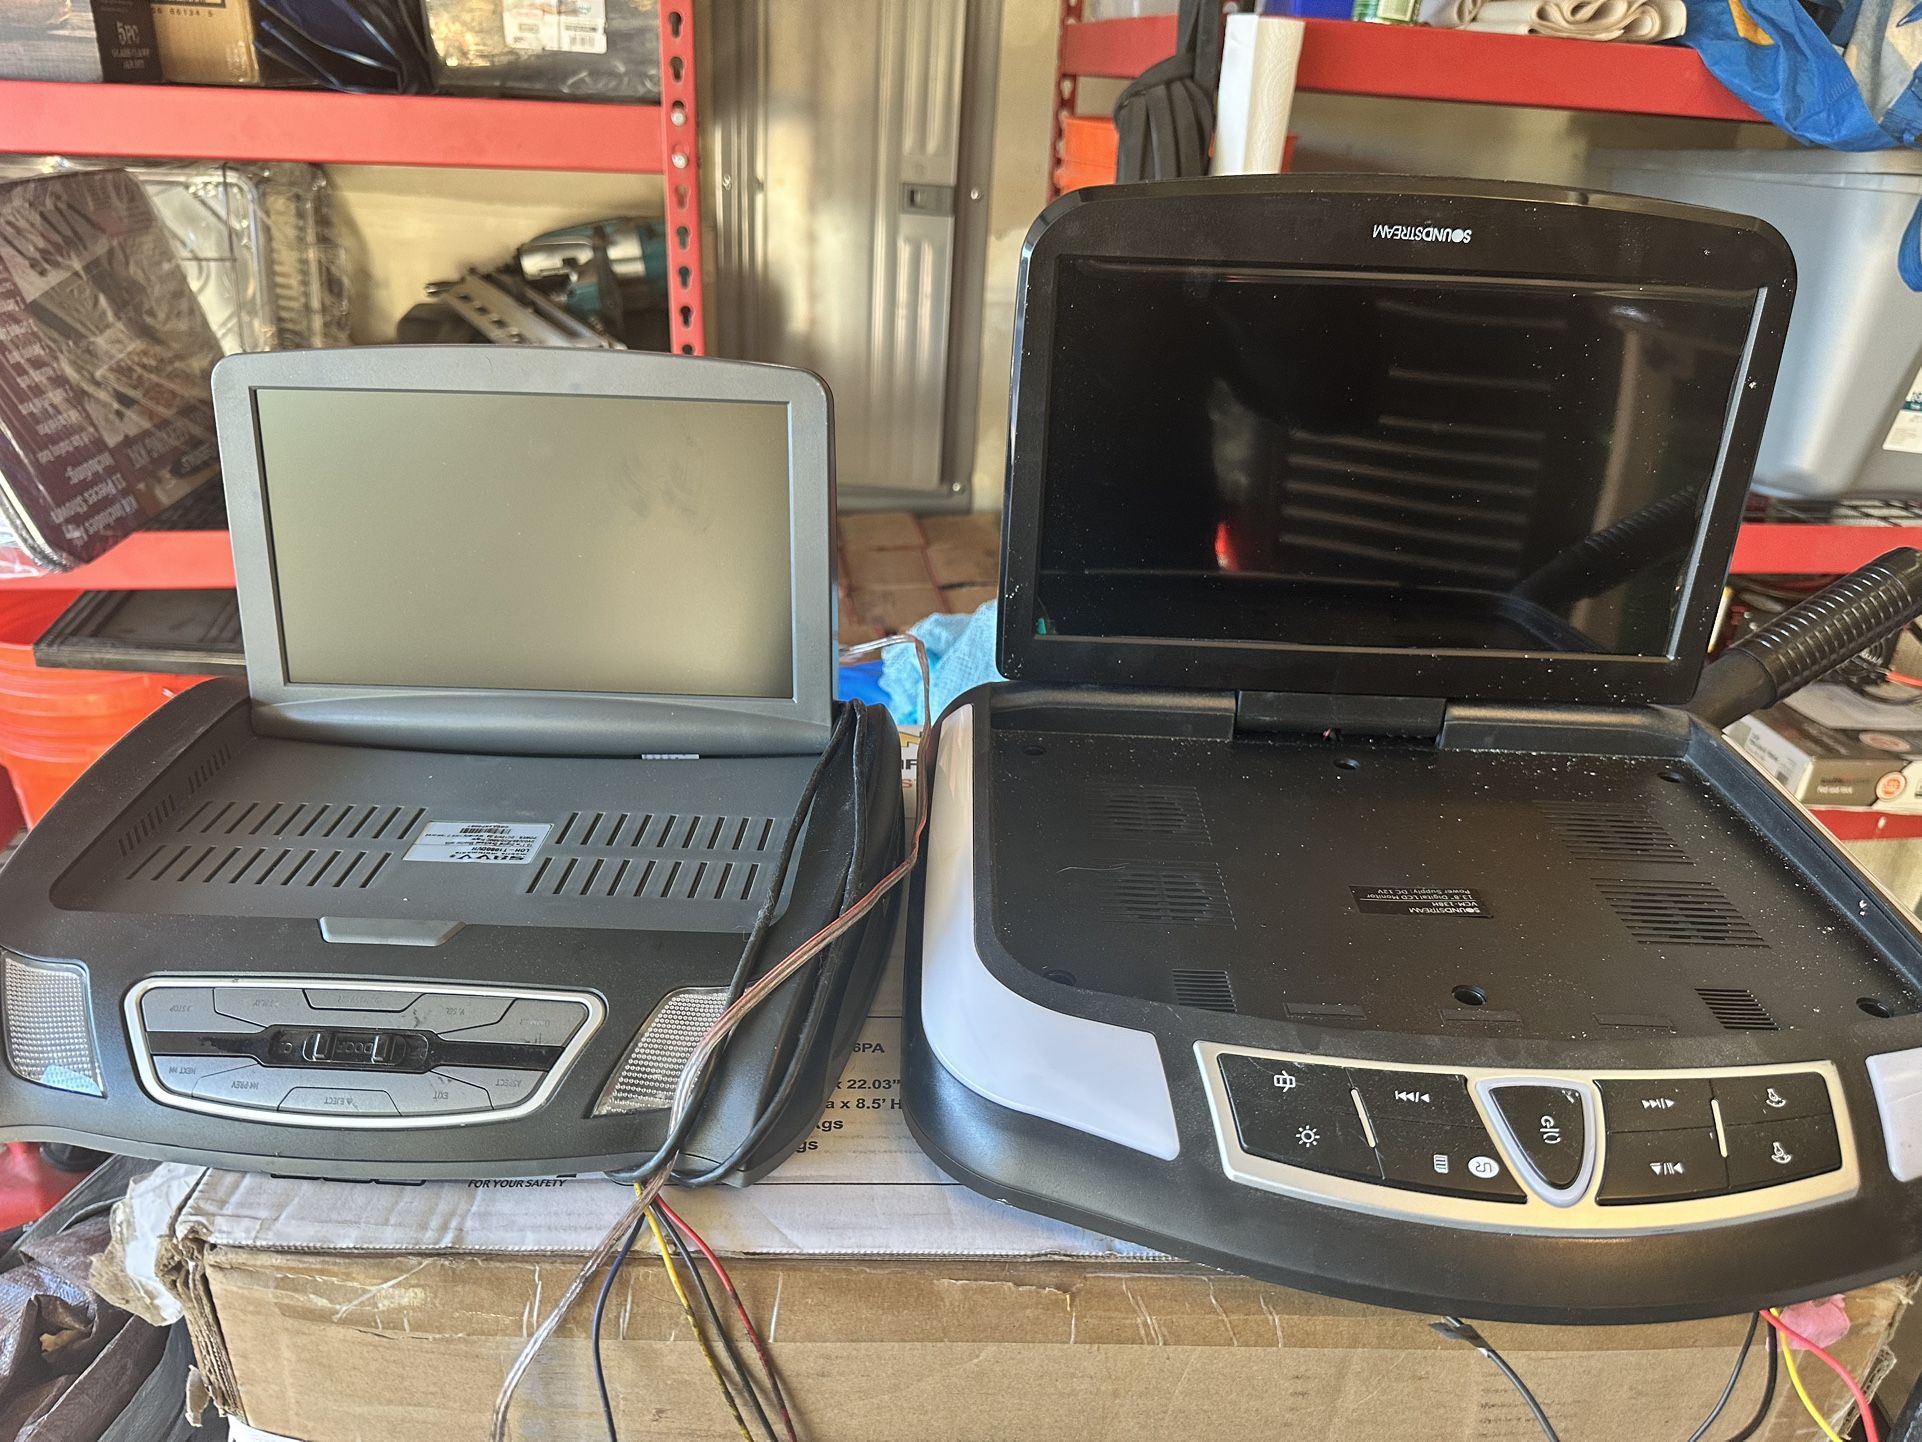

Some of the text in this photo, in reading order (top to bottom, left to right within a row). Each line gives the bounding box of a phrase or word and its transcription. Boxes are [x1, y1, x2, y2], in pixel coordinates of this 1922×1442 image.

[1372, 225, 1472, 243] SOUNDSTREAM
[179, 1066, 196, 1075] NEXT
[230, 1080, 249, 1090] PREV
[323, 1096, 345, 1105] EJECT
[432, 1091, 449, 1101] EXIT
[840, 1101, 852, 1109] x
[467, 1179, 568, 1188] FOR YOUR SAFETY
